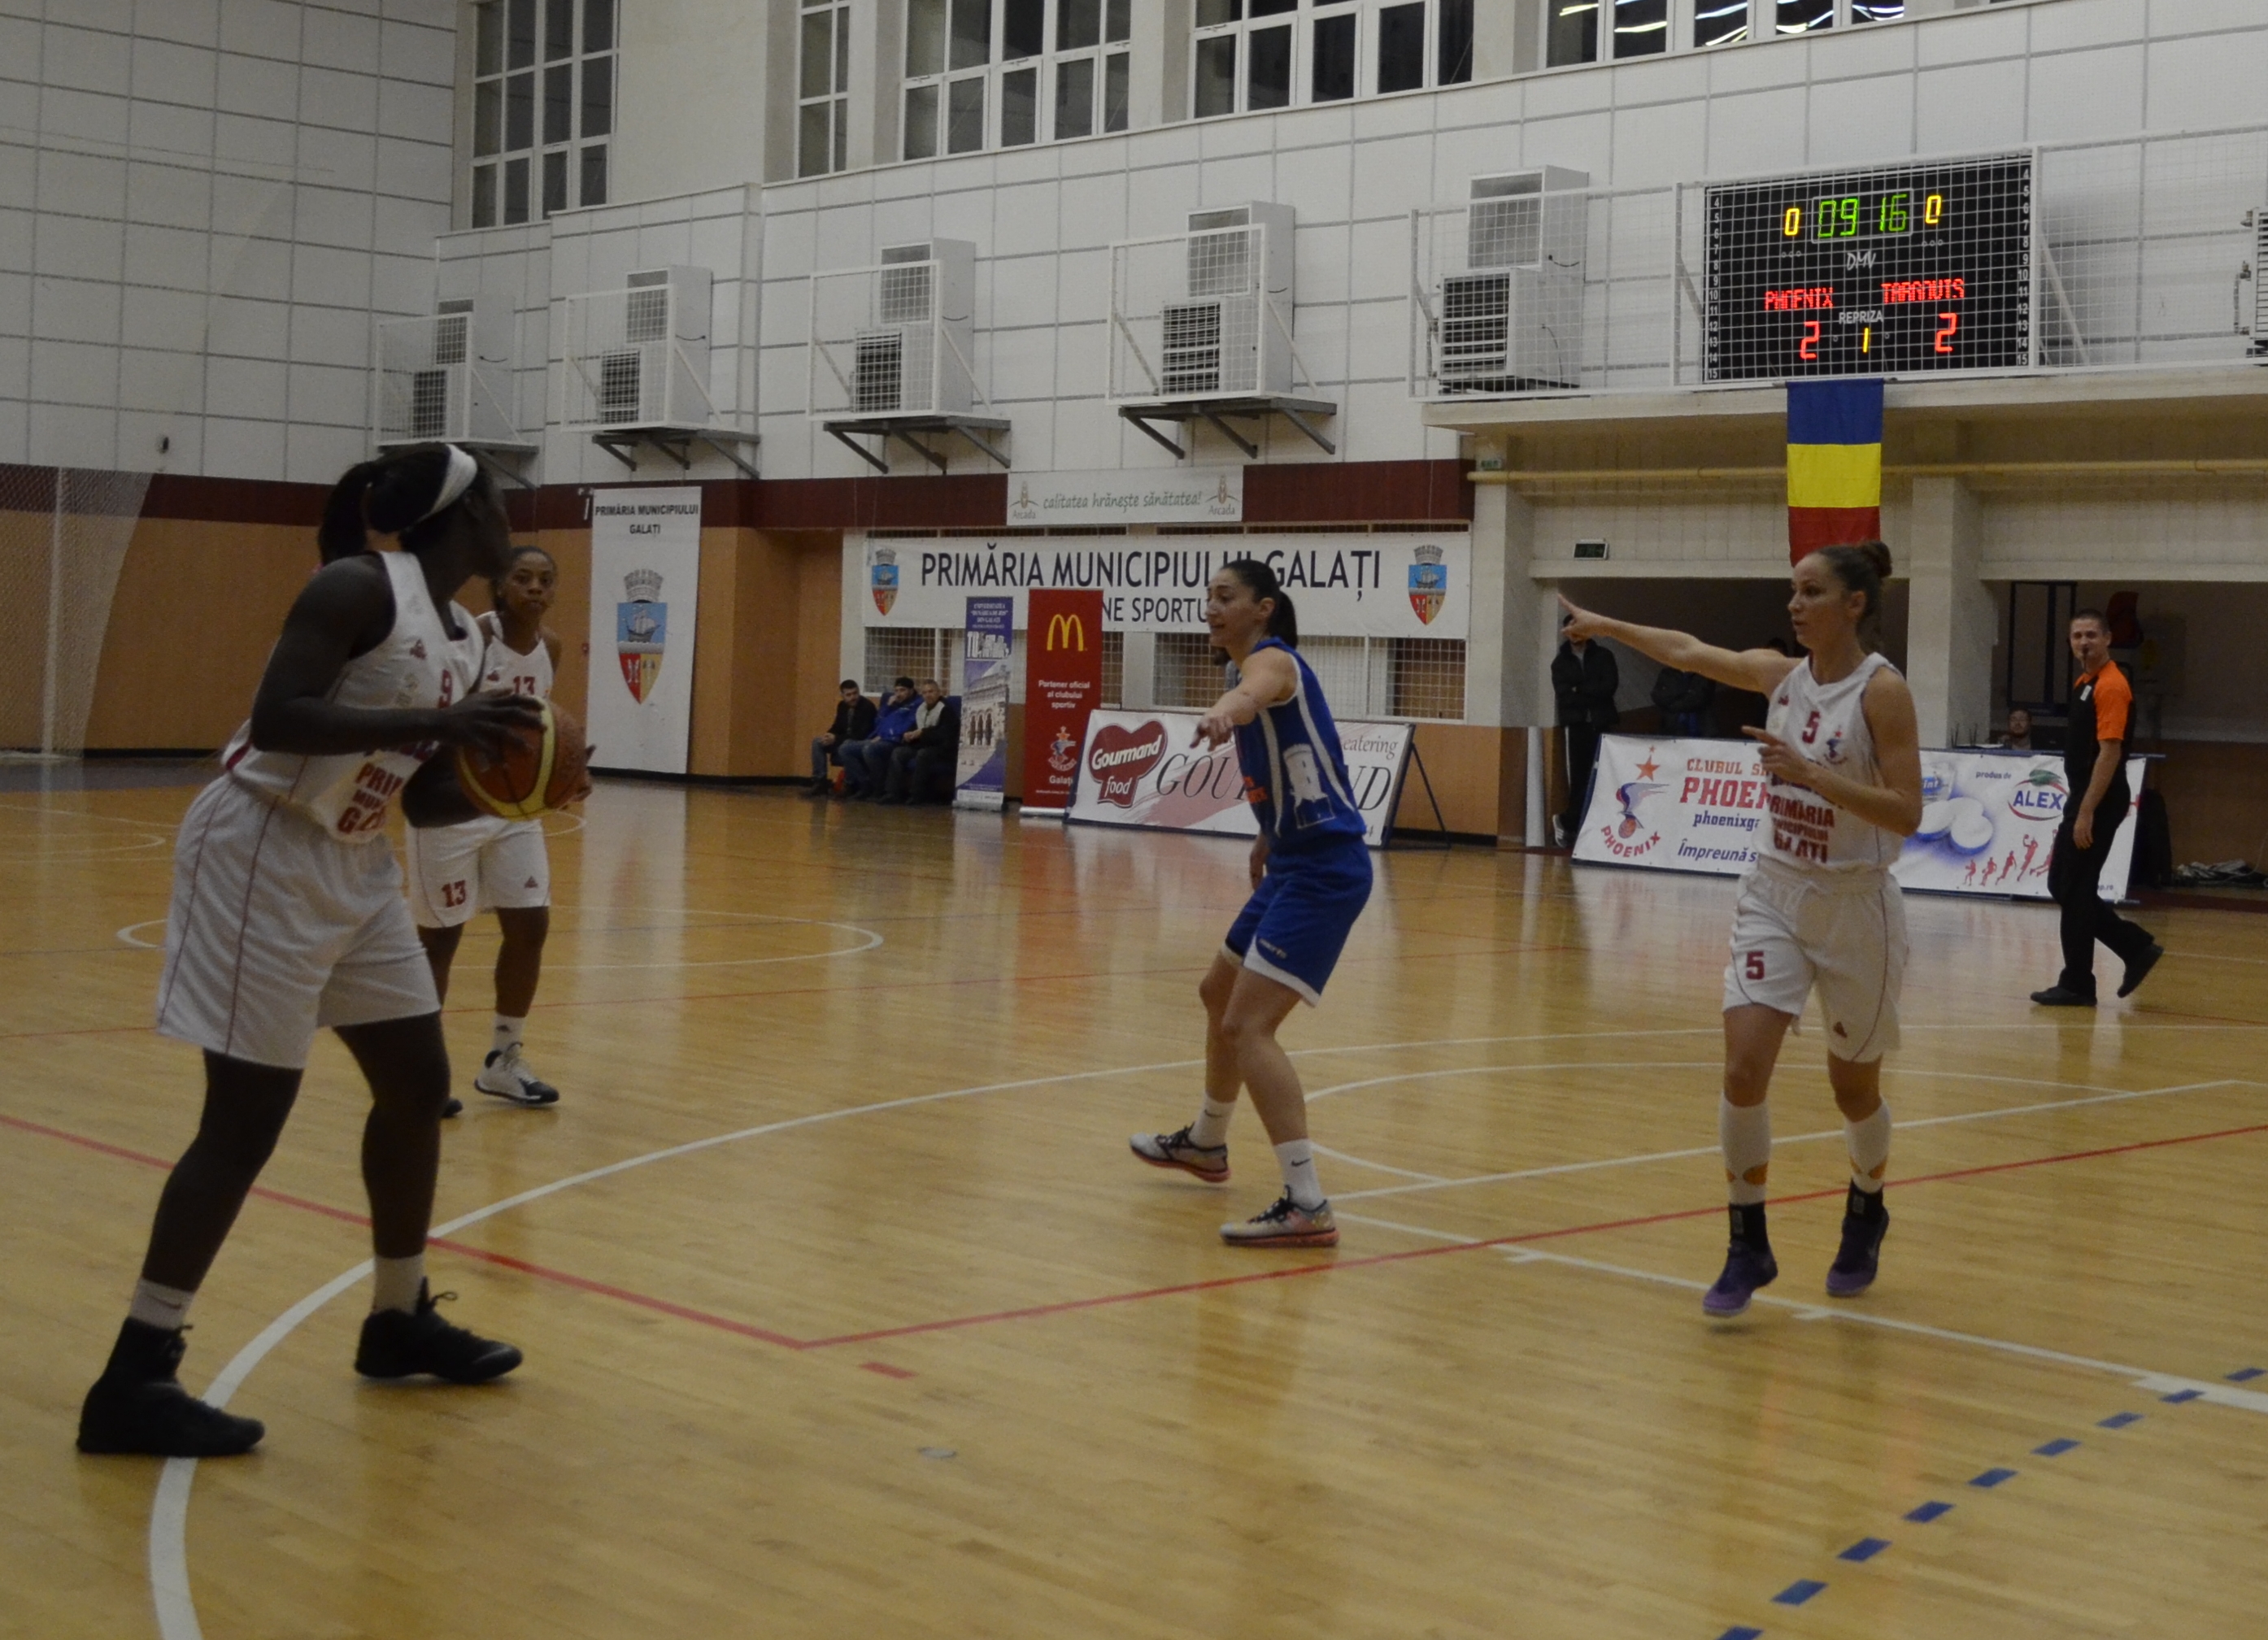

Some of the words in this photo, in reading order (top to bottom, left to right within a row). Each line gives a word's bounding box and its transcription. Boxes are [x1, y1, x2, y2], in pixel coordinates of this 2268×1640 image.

[2022, 168, 2029, 179] 4
[2023, 185, 2029, 197] 5
[1714, 198, 1719, 208] 4
[2023, 202, 2029, 214] 6
[1714, 213, 1719, 224] 5
[1785, 208, 1800, 236] 0
[1926, 195, 1941, 224] 0
[2023, 220, 2029, 231] 7
[1713, 228, 1719, 239] 6
[2022, 236, 2029, 248] 8
[1713, 244, 1719, 254] 7
[1713, 259, 1719, 271] 8
[1847, 250, 1876, 270] DMV
[2022, 254, 2029, 265] 9
[1713, 275, 1718, 286] 9
[2018, 269, 2028, 281] 10
[1709, 289, 1718, 300] 10
[2018, 286, 2028, 298] 11
[1709, 305, 1718, 315] 11
[2018, 303, 2028, 315] 12
[1839, 310, 1883, 324] REPRIZA
[1709, 321, 1718, 332] 12
[2018, 320, 2028, 332] 13
[1800, 321, 1819, 359] 2
[1863, 328, 1869, 353] 1
[1935, 312, 1957, 351] 2
[1709, 337, 1718, 348] 13
[2018, 337, 2027, 348] 14
[1709, 352, 1717, 363] 14
[2018, 354, 2027, 365] 15
[1709, 368, 1717, 379] 15
[1043, 493, 1088, 509] calitatea
[638, 504, 699, 515] MUNICIPIULUI
[1208, 504, 1235, 515] Arcada
[922, 542, 1044, 586] PRIMĂRIA
[512, 676, 535, 695] 13
[1801, 711, 1822, 744] 5
[1092, 735, 1163, 769] Gourmand
[1687, 759, 1743, 774] CLUBUL
[1976, 771, 2002, 779] produs
[1104, 775, 1134, 798] food
[2013, 790, 2066, 811] ALEX
[1600, 824, 1661, 858] PHOENIX
[1678, 837, 1749, 861] Împreună
[442, 880, 467, 908] 13
[1746, 951, 1765, 980] 5
